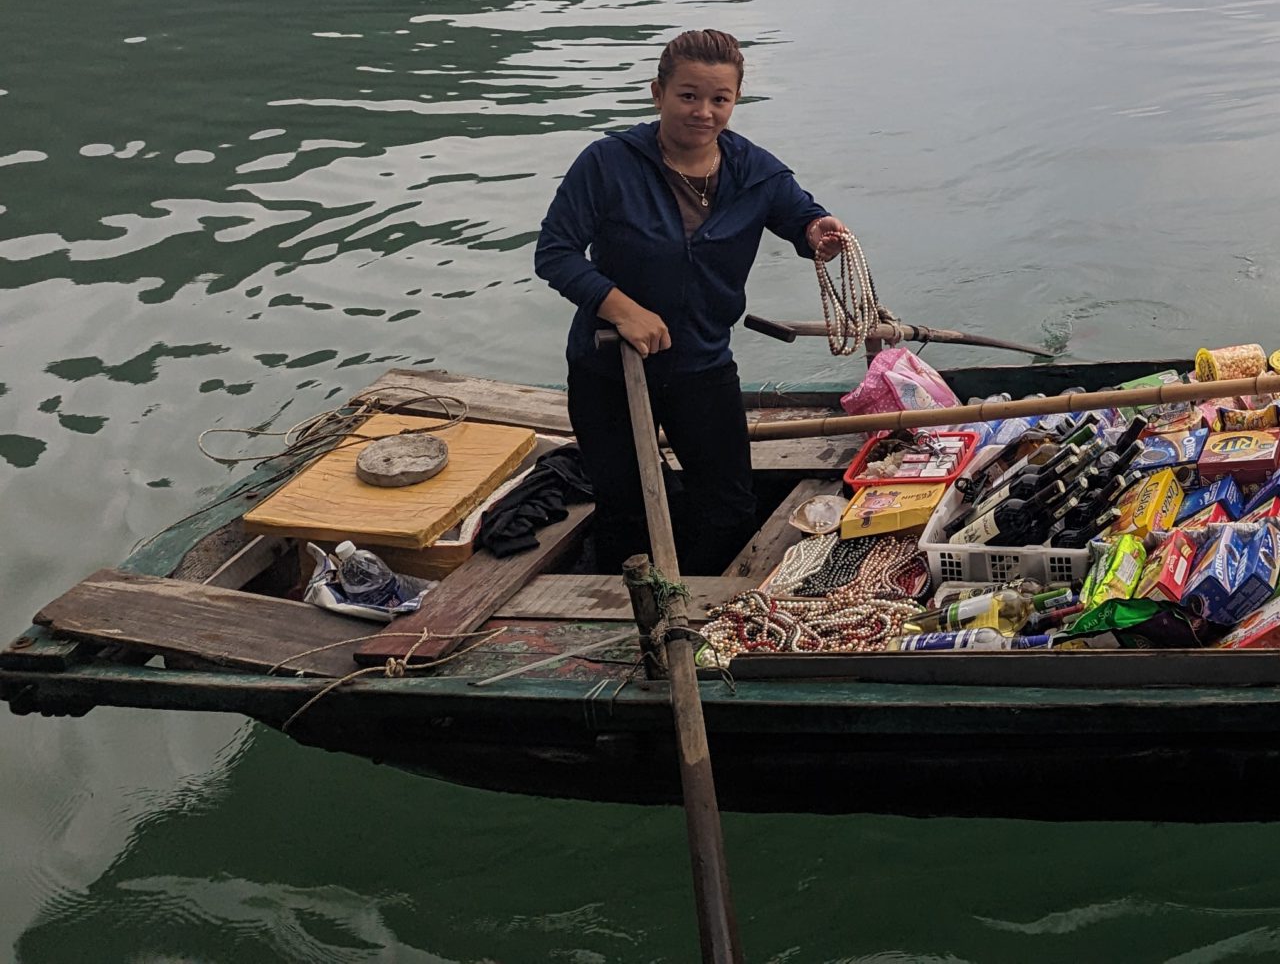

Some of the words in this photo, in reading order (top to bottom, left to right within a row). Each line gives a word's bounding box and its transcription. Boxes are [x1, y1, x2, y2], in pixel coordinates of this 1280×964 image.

[1183, 437, 1195, 458] OREO
[1214, 437, 1258, 452] RITZ
[1215, 552, 1224, 580] OREO
